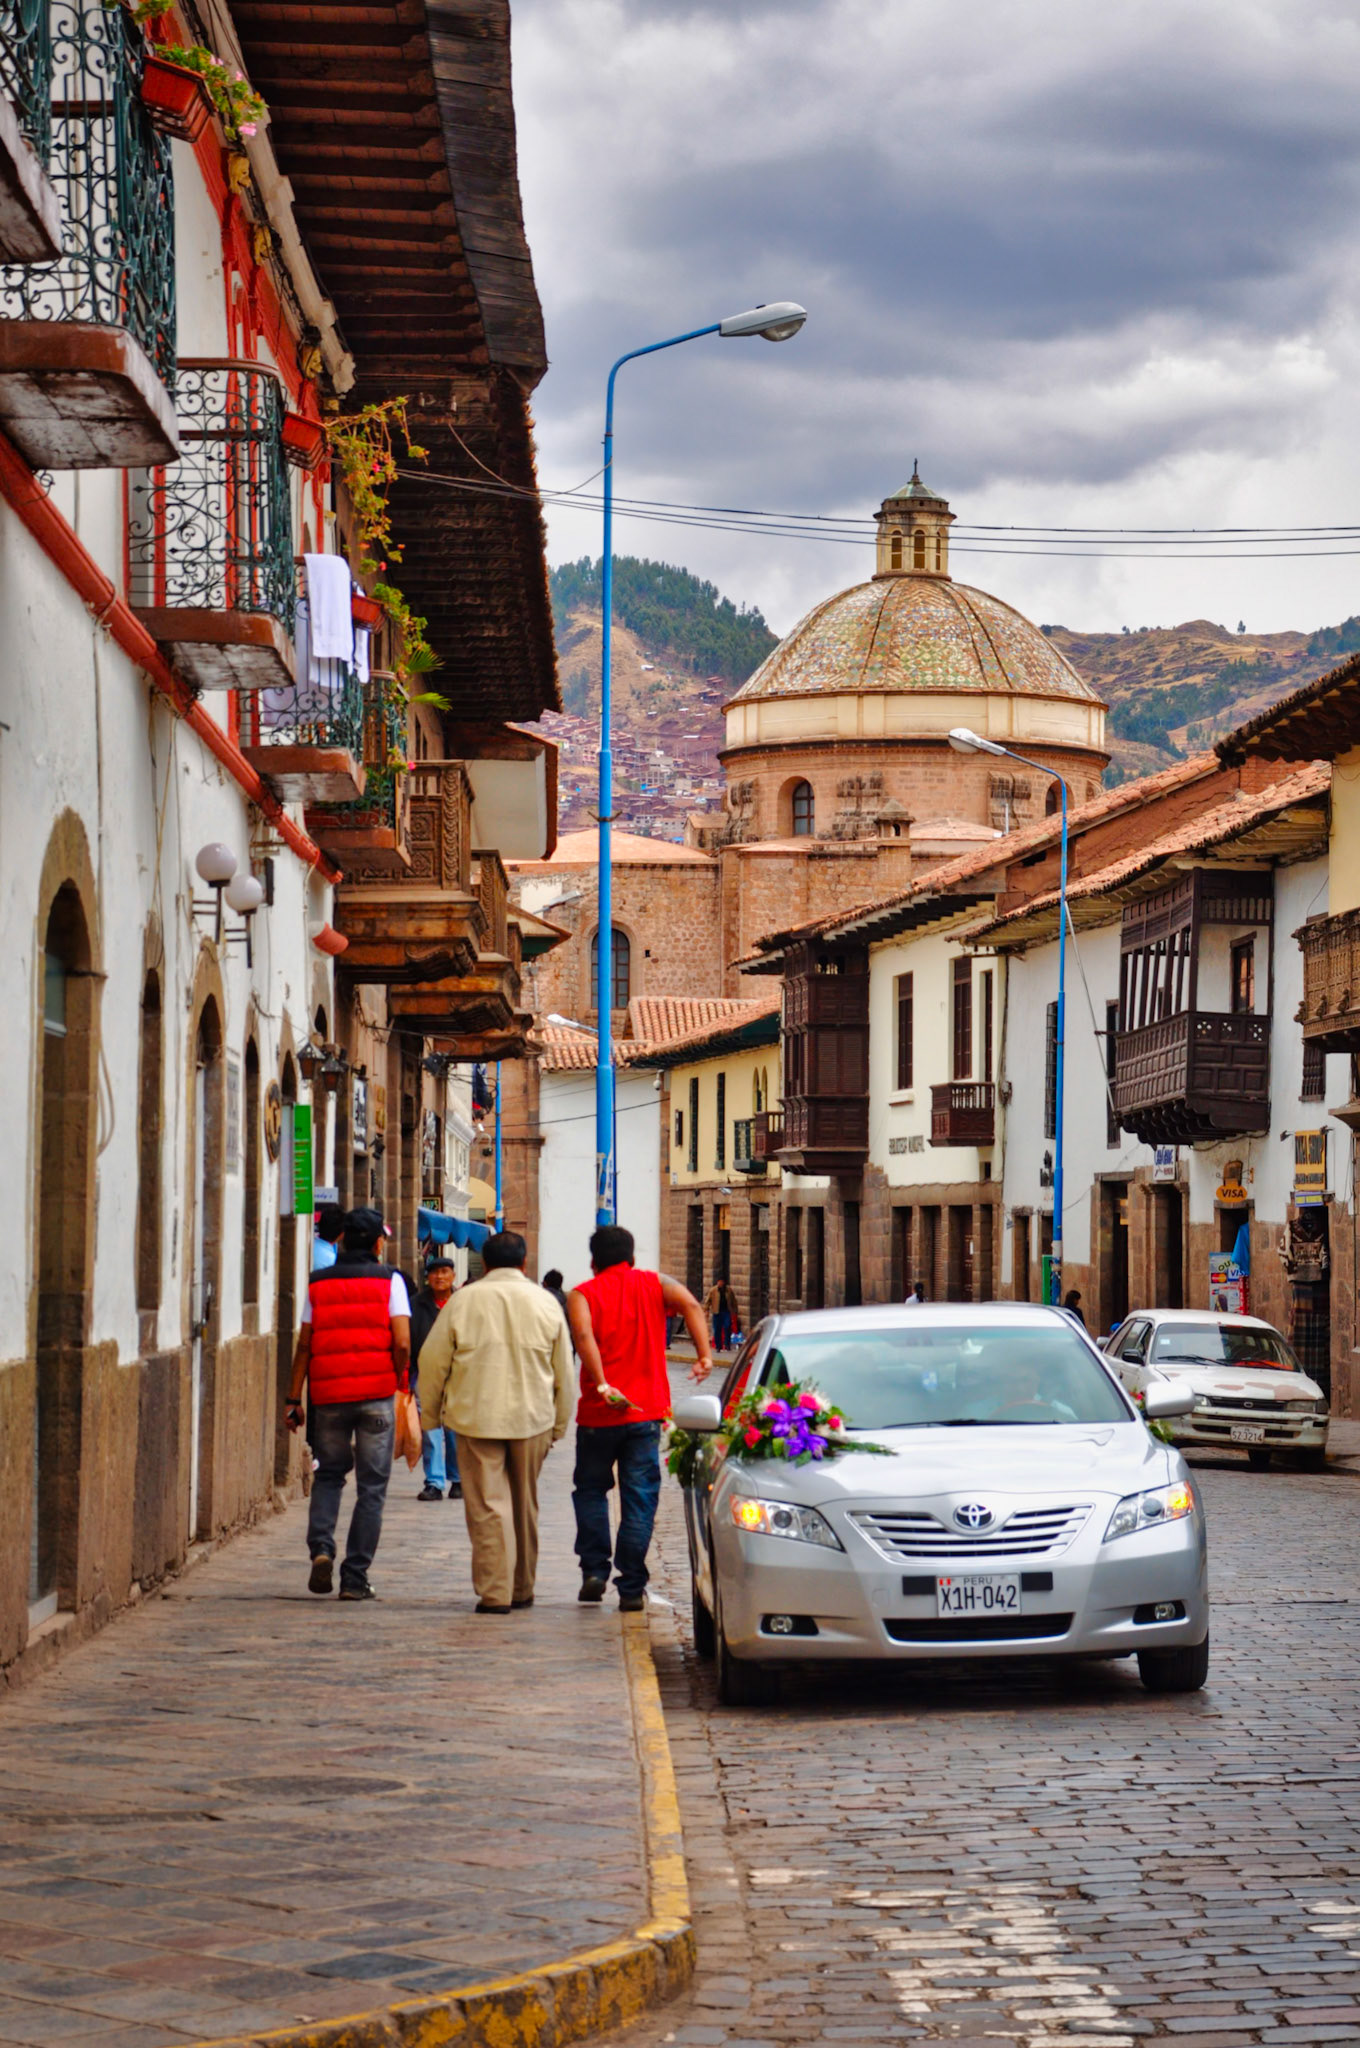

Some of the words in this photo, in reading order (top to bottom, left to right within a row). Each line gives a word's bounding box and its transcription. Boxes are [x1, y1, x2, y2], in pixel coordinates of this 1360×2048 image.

[1221, 1189, 1244, 1198] VISA
[963, 1577, 993, 1586] PERU
[941, 1585, 1017, 1611] X1H-042
